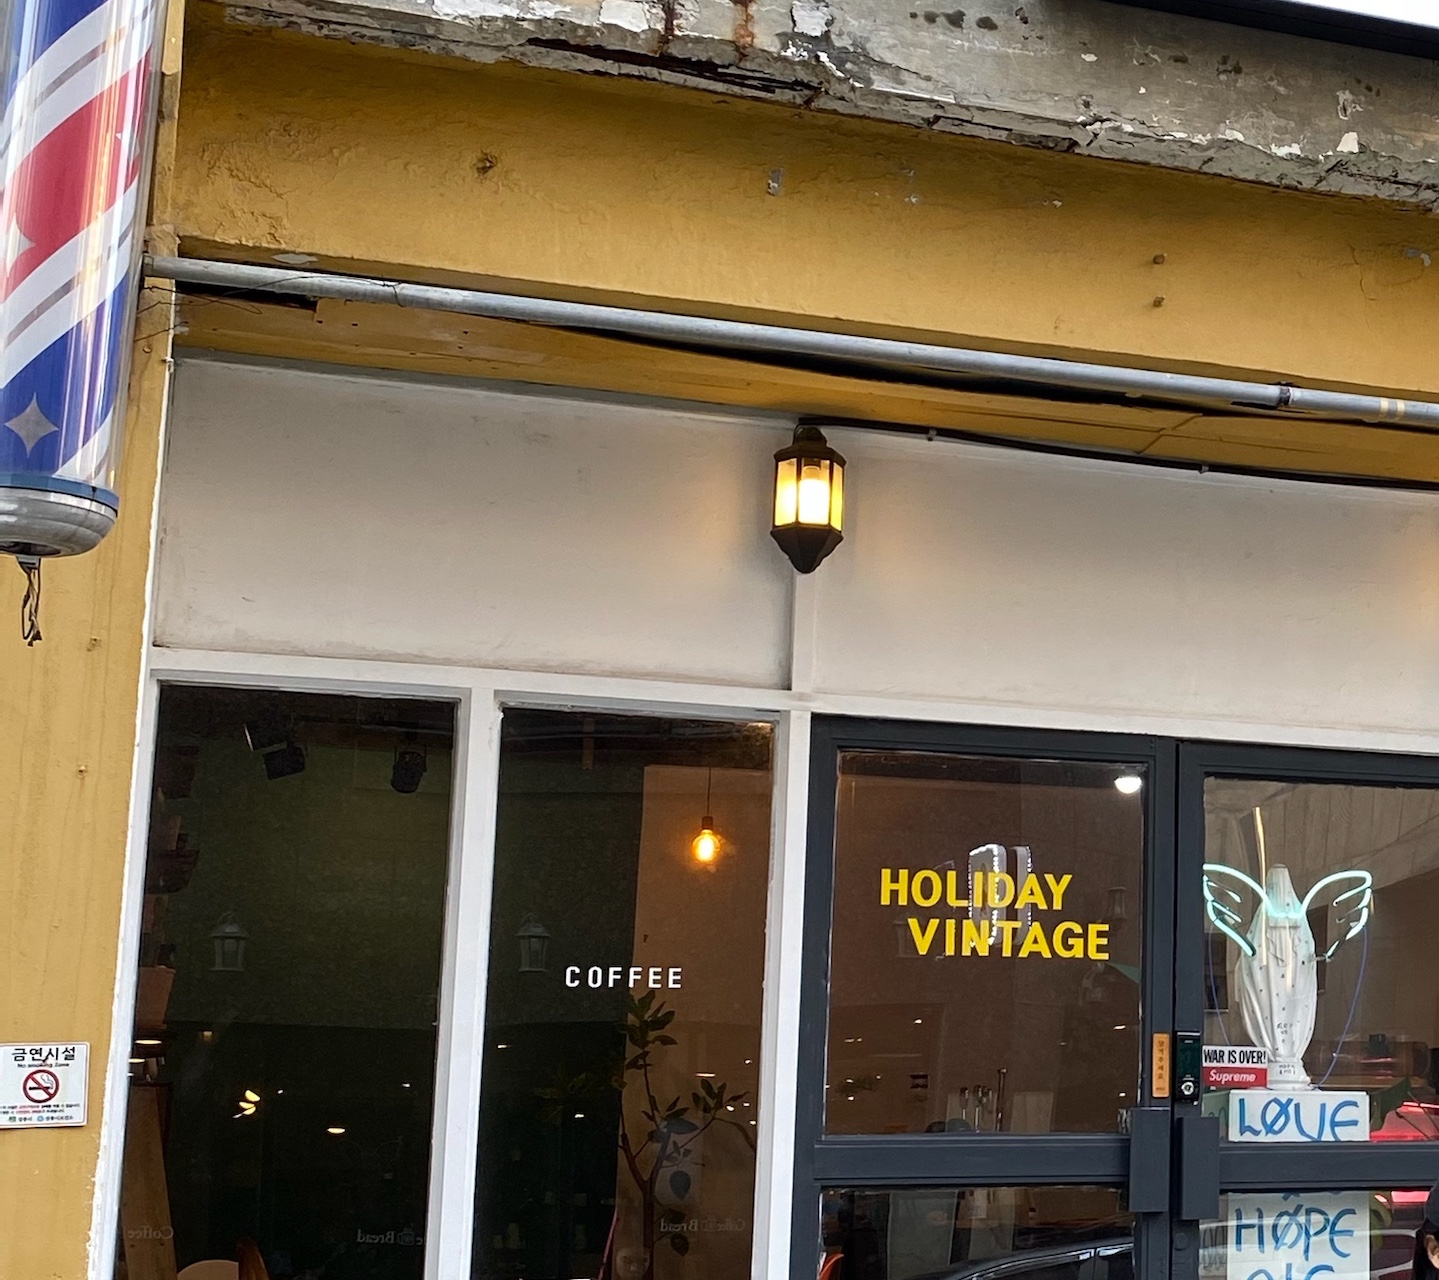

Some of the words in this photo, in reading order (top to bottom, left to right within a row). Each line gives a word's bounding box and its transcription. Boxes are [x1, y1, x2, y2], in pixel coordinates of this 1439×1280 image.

[880, 868, 1073, 911] HOLIDAY
[907, 917, 1110, 960] VINTAGE
[565, 965, 683, 989] COFFEE
[12, 1046, 76, 1062] 금연시설
[1203, 1049, 1225, 1064] WAR
[1228, 1049, 1237, 1064] IS
[1238, 1050, 1266, 1065] OVER!
[1209, 1070, 1257, 1086] Supreme
